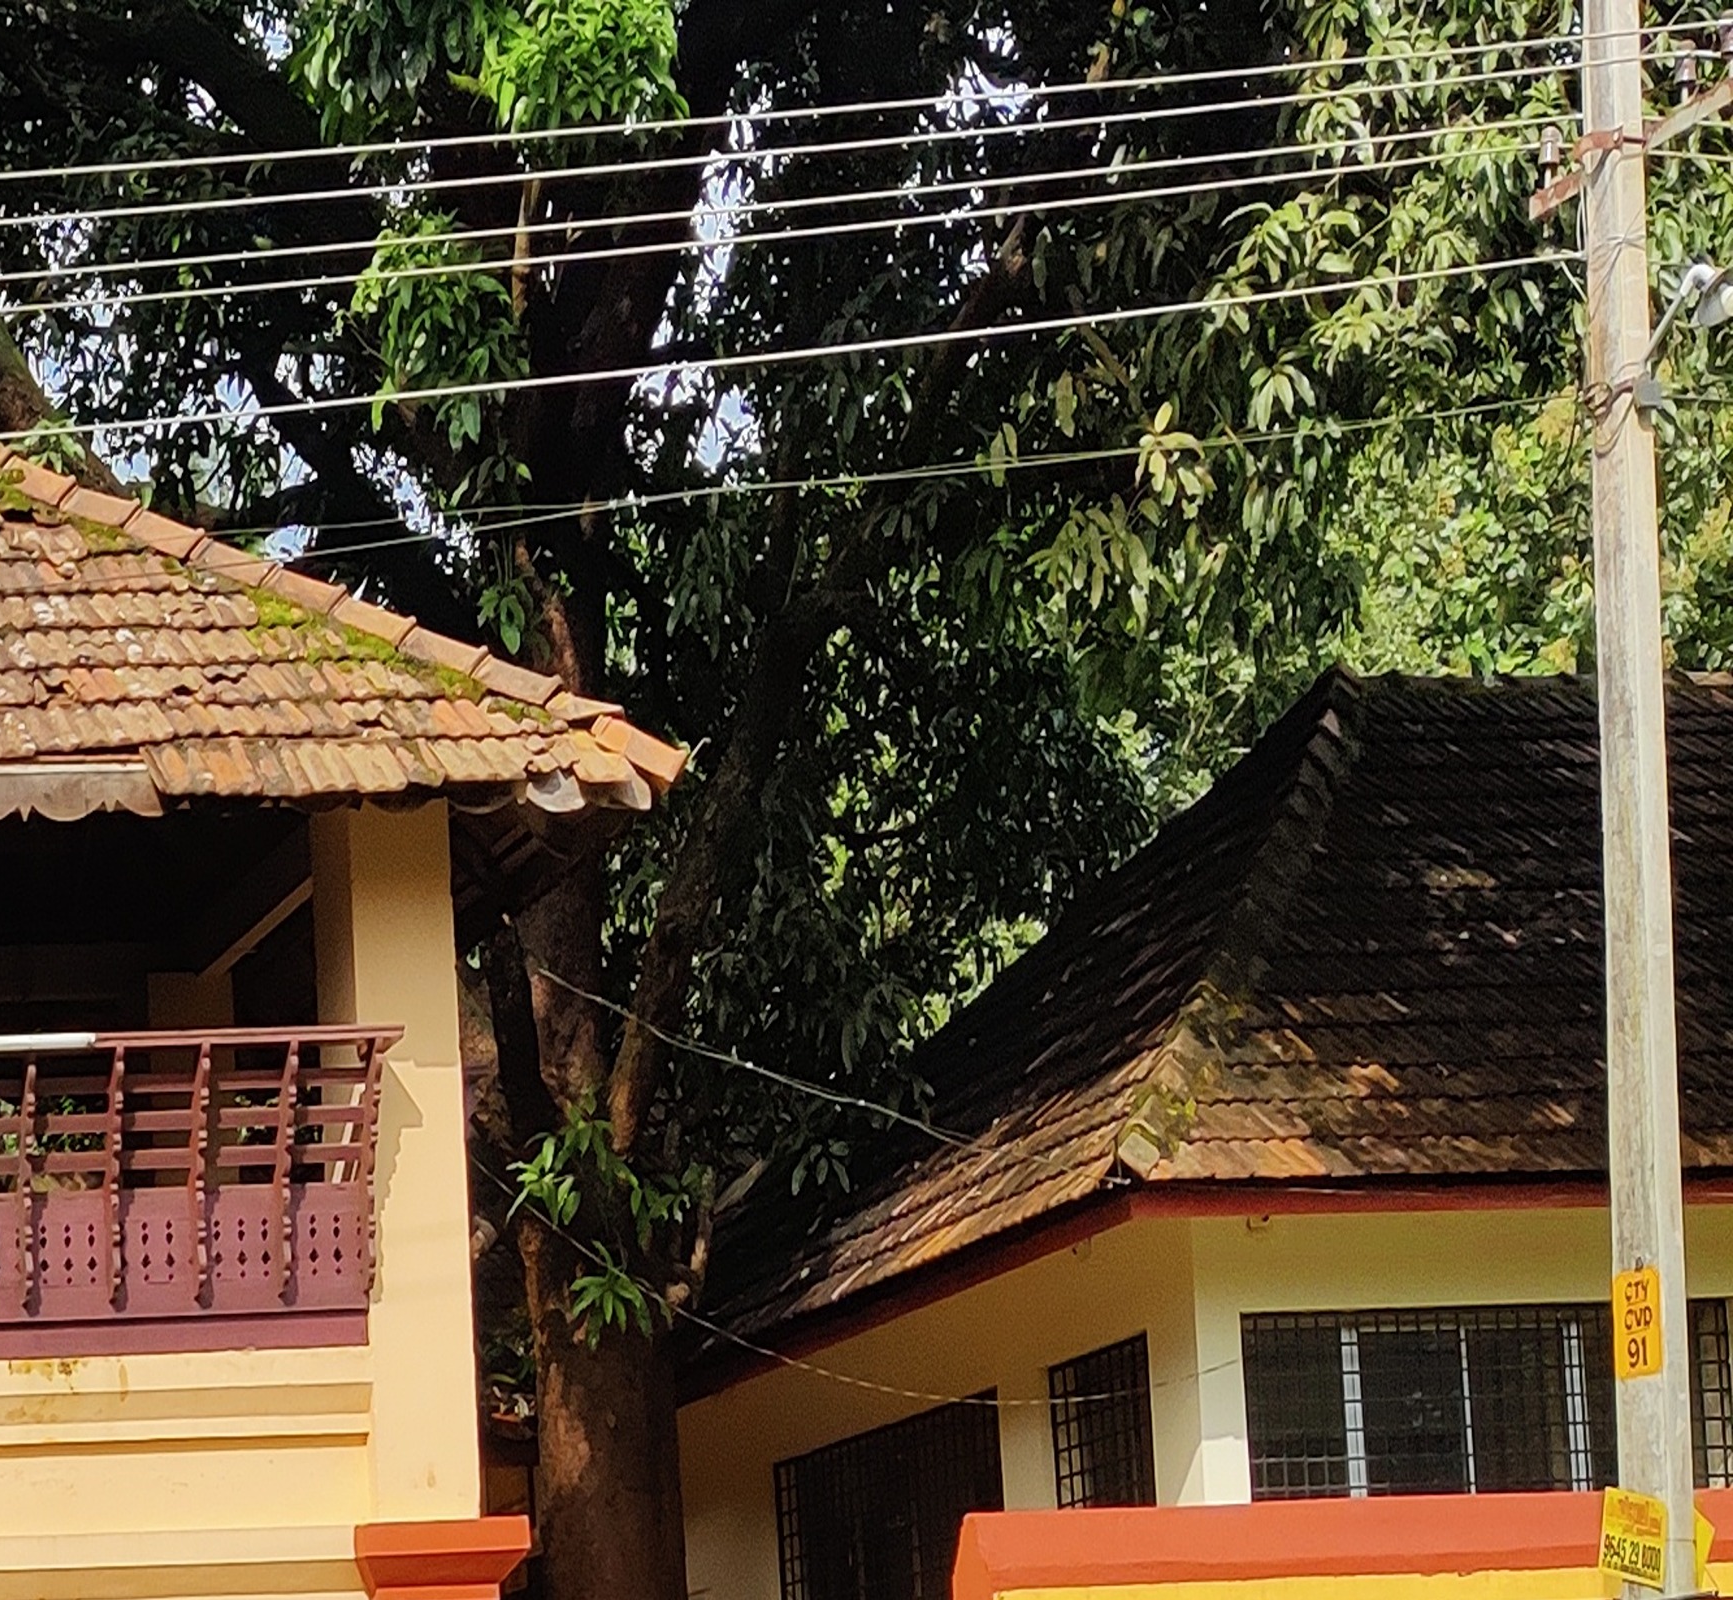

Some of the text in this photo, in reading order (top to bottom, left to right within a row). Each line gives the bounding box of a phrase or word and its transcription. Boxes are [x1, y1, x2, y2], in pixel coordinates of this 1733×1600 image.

[1625, 1279, 1650, 1302] CTY
[1625, 1306, 1653, 1331] CVD
[1628, 1336, 1648, 1369] 91
